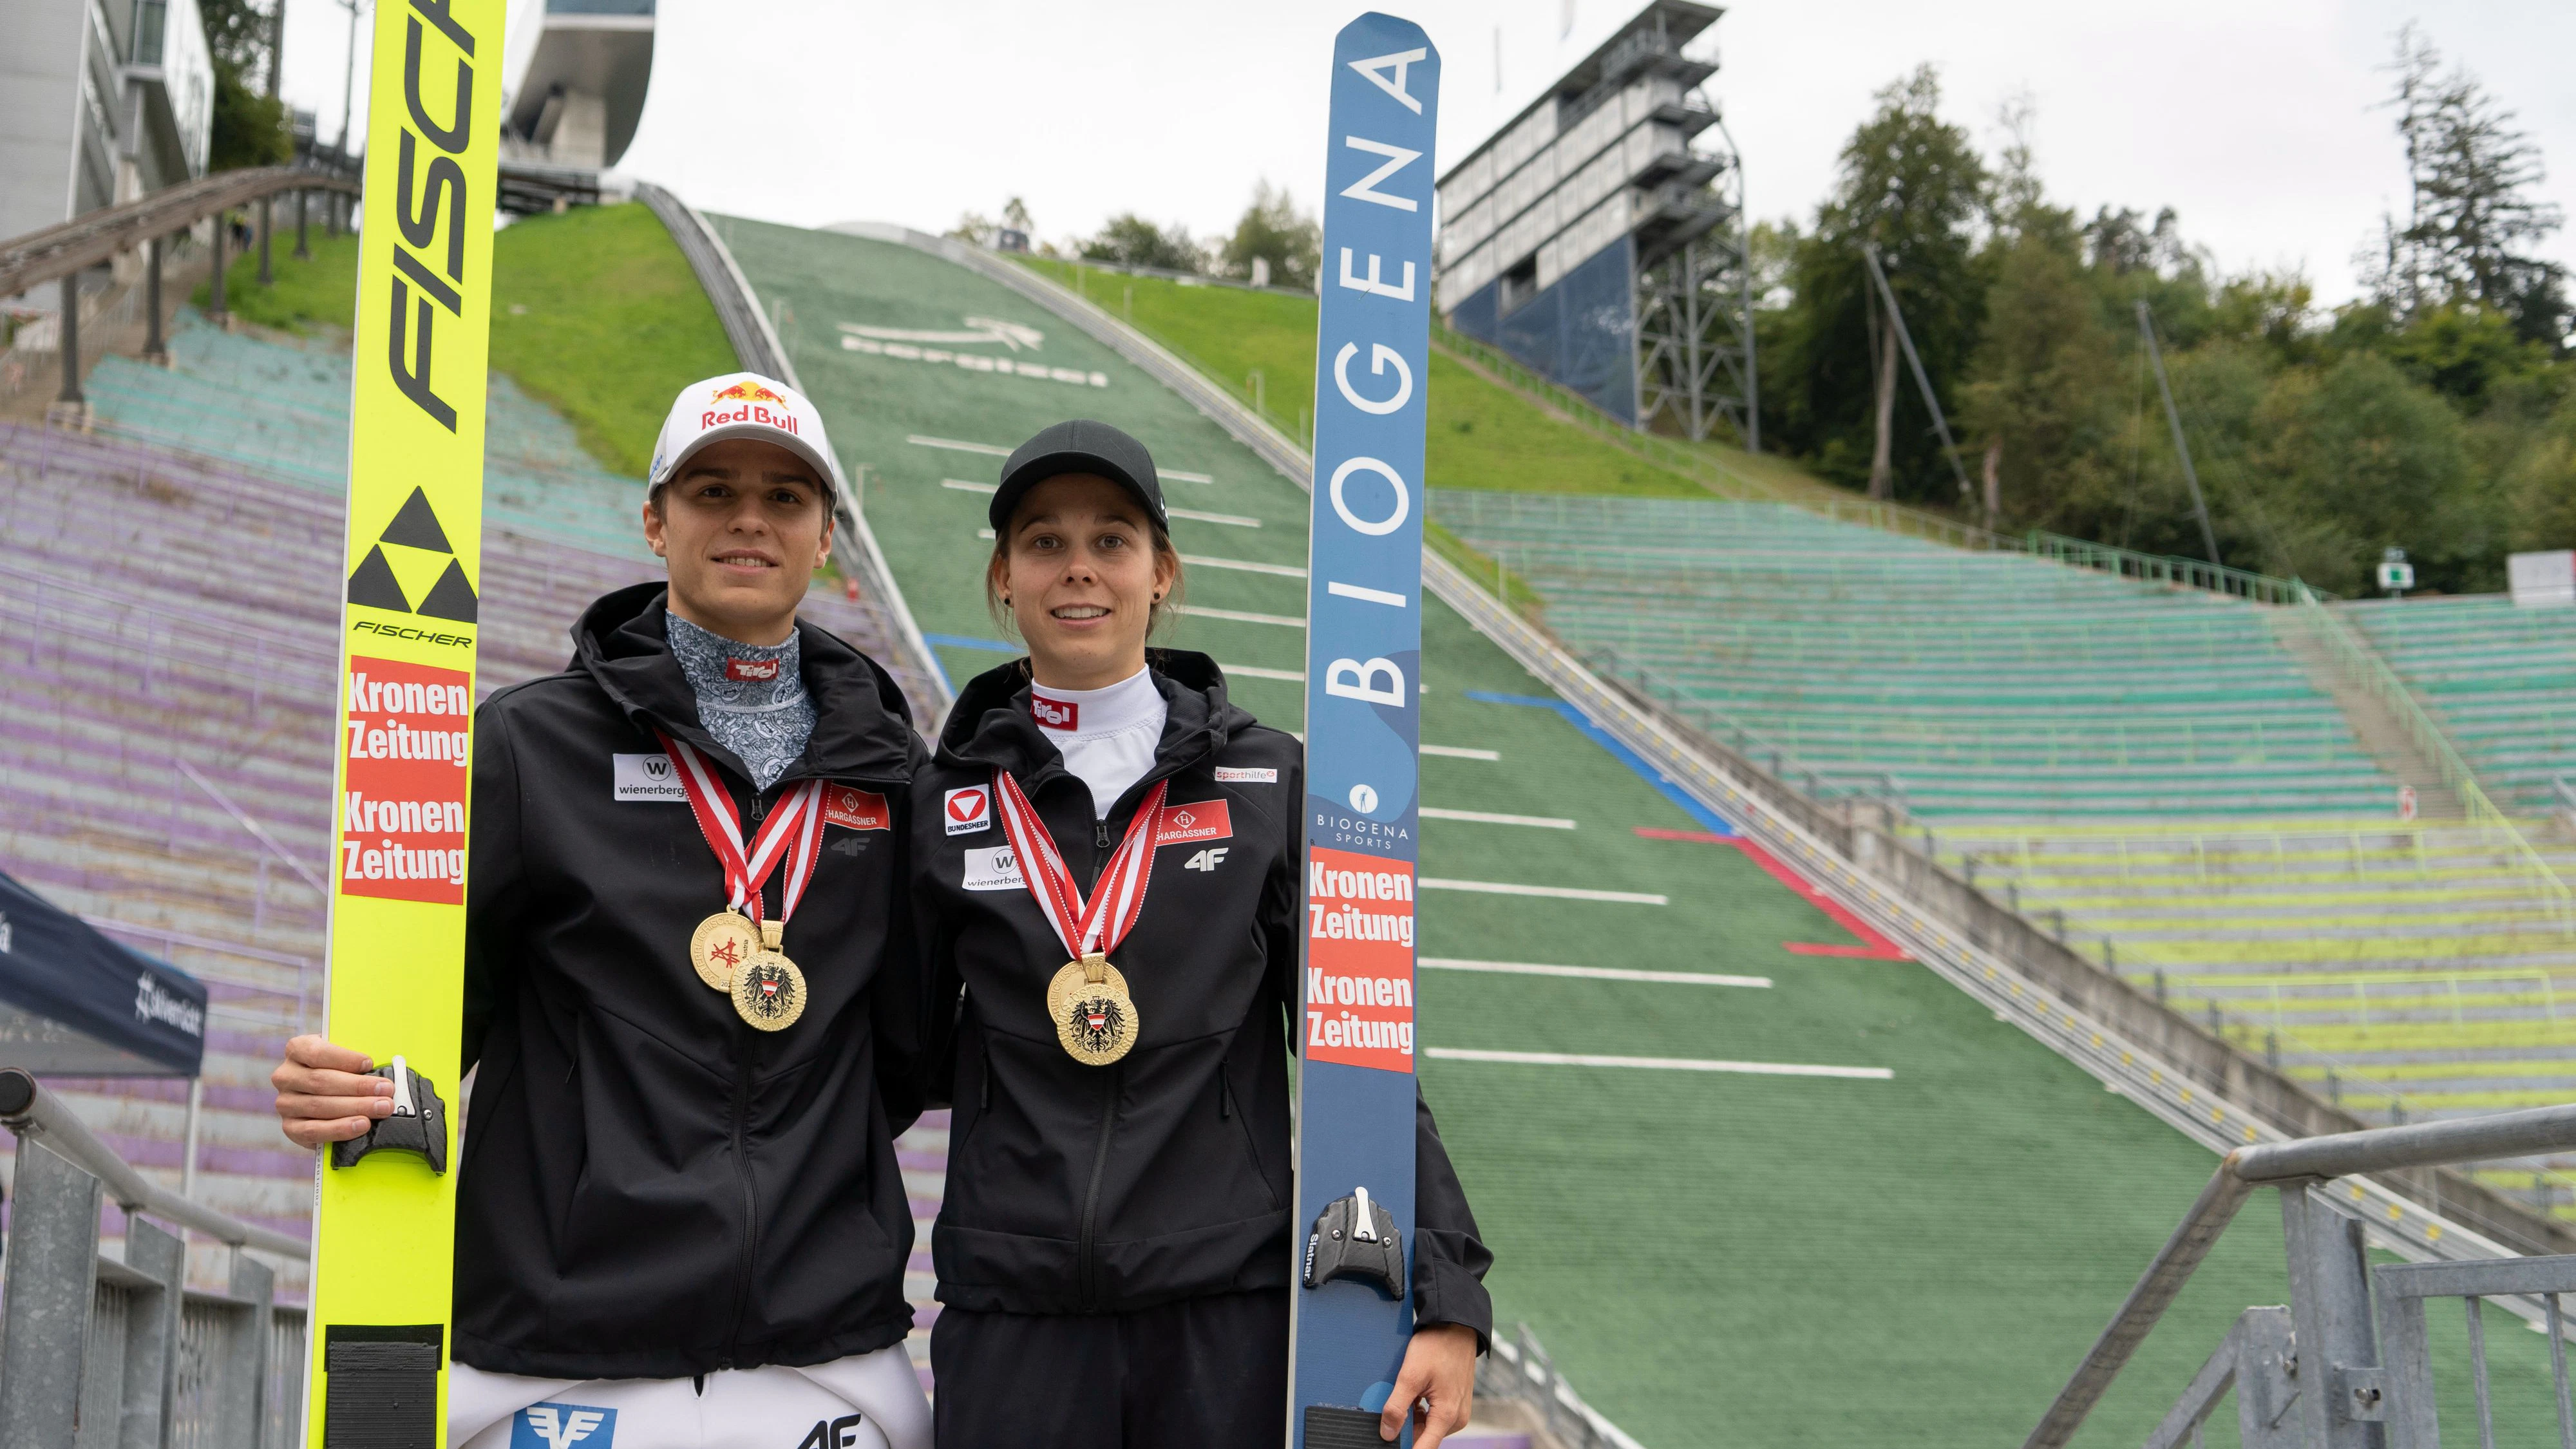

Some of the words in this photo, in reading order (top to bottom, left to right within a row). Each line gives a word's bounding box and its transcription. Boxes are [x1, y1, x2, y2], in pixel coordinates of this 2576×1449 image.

[1325, 47, 1428, 708] BIOGENA
[701, 405, 749, 430] Red
[753, 406, 799, 435] Bull
[353, 621, 472, 649] FISCHER
[735, 663, 777, 679] Tirol
[348, 672, 468, 715] Kronen
[1033, 699, 1070, 725] Tirol
[348, 719, 468, 767] Zeitung
[646, 762, 667, 775] W
[1217, 771, 1267, 781] sporthilfe
[619, 784, 685, 798] wienerberg
[343, 791, 465, 833] Kronen
[828, 809, 877, 826] HARGASSNER
[947, 820, 989, 833] BUNDESHEER
[1157, 827, 1217, 842] HARGASSNER
[1317, 814, 1408, 840] BIOGENA
[831, 837, 871, 857] 4F
[1336, 833, 1392, 850] SPORTS
[343, 838, 466, 885] Zeitung
[996, 855, 1014, 869] W
[1184, 847, 1229, 871] 4F
[1309, 861, 1413, 902] Kronen
[1308, 903, 1414, 948] Zeitung
[1307, 967, 1412, 1007] Kronen
[1307, 1011, 1414, 1056] Zeitung
[1304, 1233, 1319, 1280] Slatnar
